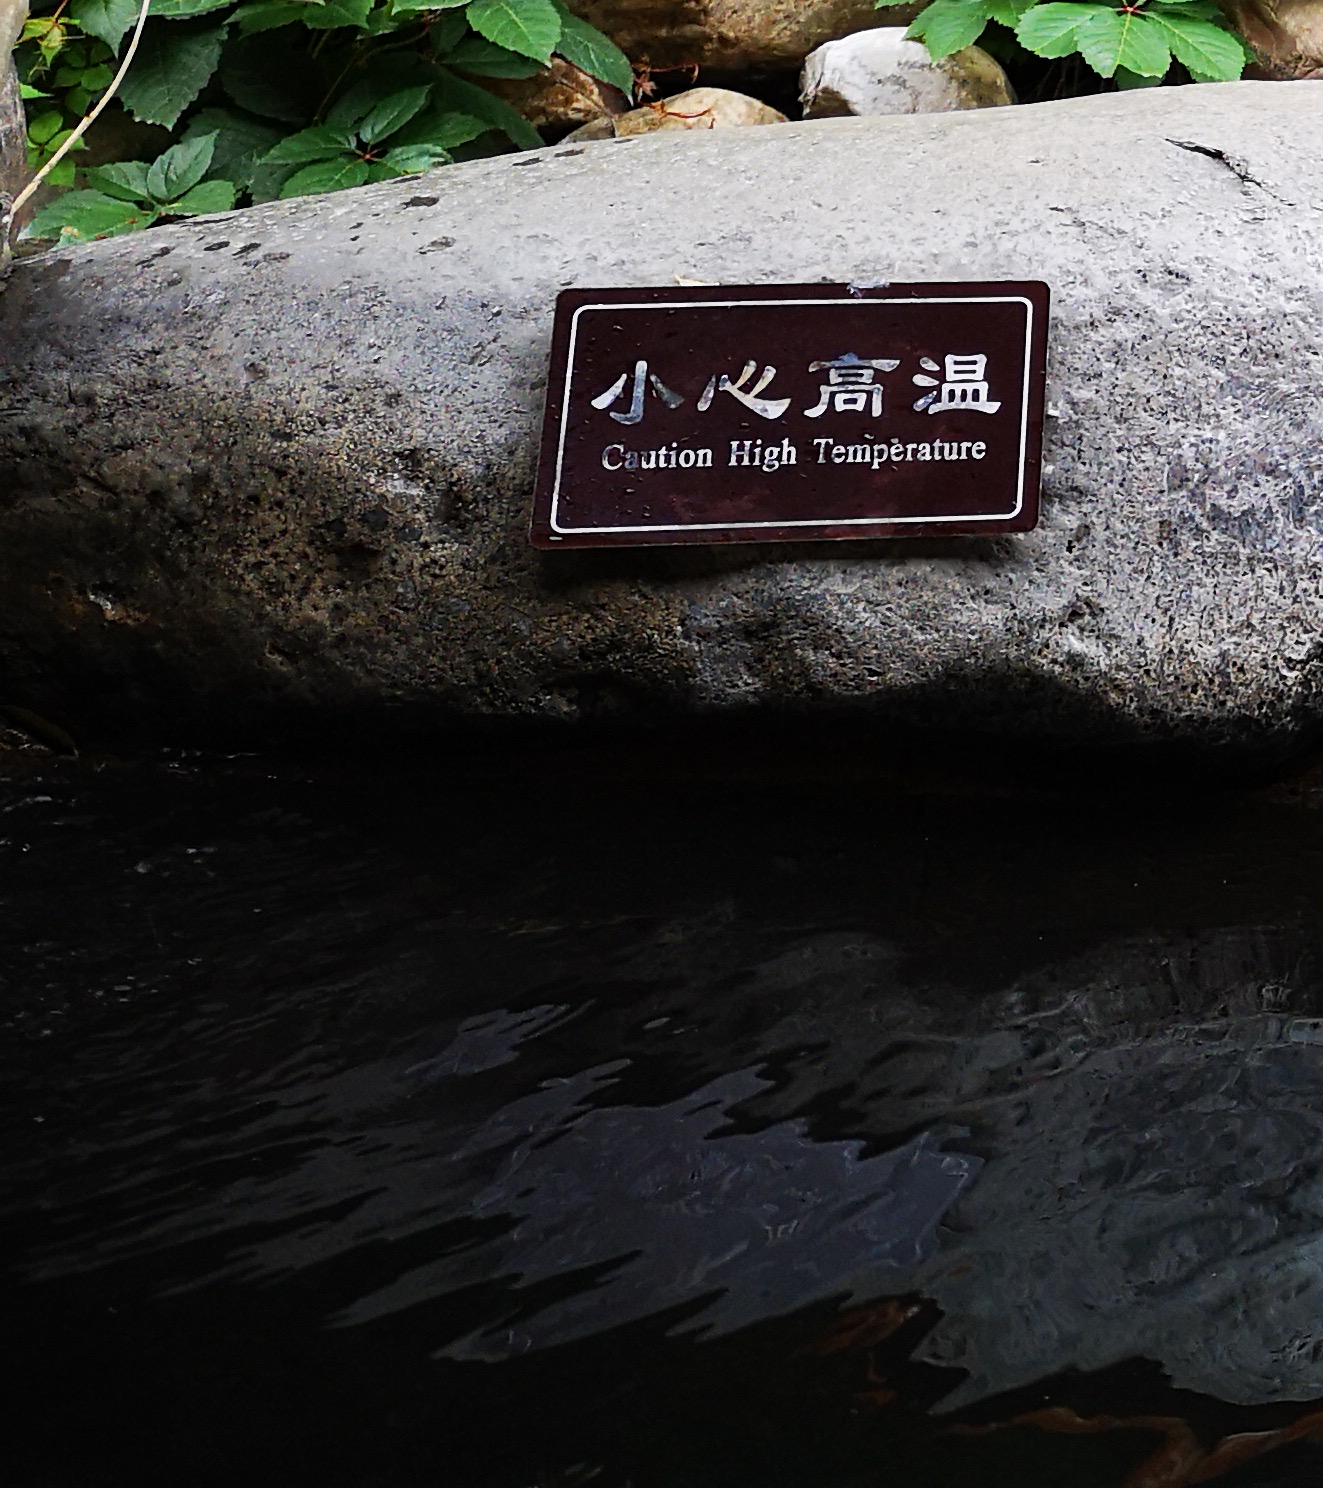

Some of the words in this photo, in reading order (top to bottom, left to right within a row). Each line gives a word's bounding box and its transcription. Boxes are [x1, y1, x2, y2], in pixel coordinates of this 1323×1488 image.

[590, 352, 1002, 425] 小心高温
[602, 442, 713, 472] Caution
[728, 438, 798, 473] High
[813, 437, 987, 469] Temperature
